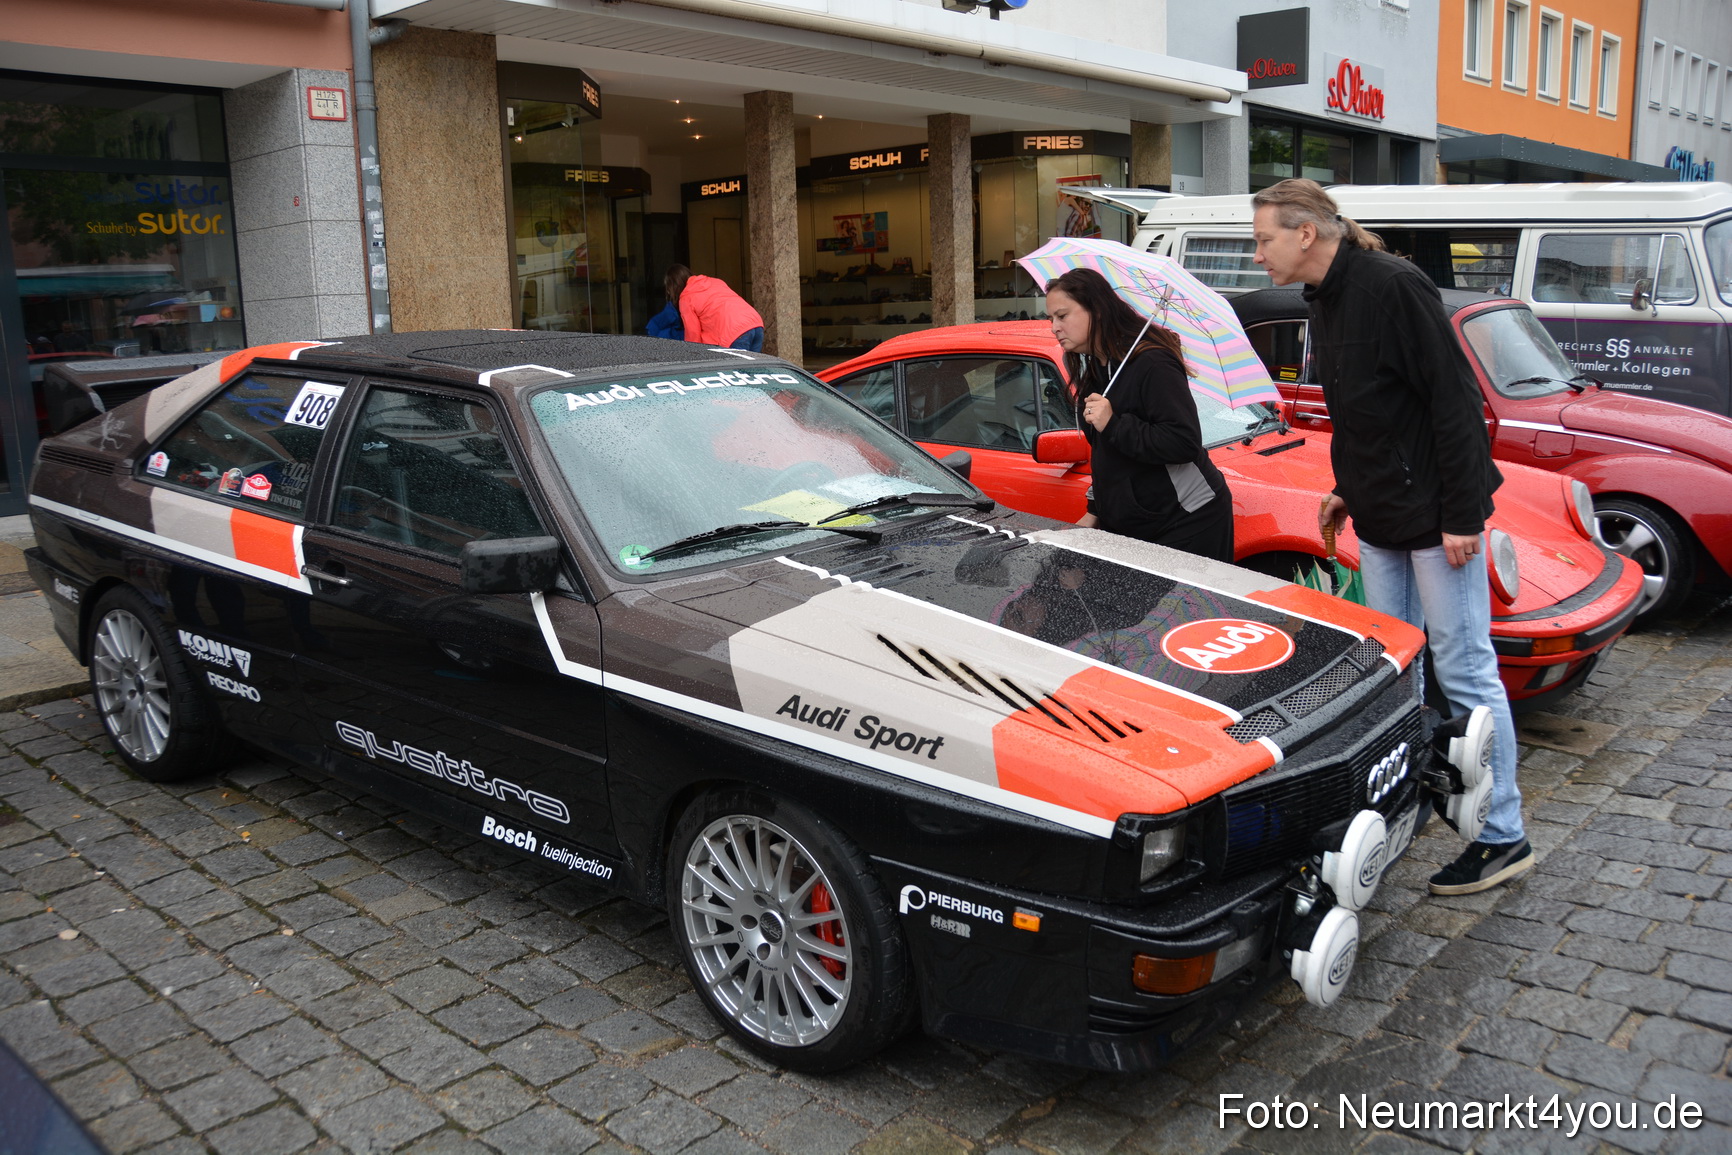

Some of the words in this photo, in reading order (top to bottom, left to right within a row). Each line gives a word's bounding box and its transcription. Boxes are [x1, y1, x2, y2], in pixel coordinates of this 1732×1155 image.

[582, 80, 599, 108] FRIES
[1327, 58, 1385, 119] s.Oliver
[1023, 135, 1084, 150] FRIES
[850, 151, 902, 170] SCHUH
[565, 170, 610, 183] FRIES
[701, 180, 741, 196] SCHUH
[86, 222, 123, 234] Schuhe
[124, 222, 137, 236] by
[1557, 342, 1602, 352] RECHTS
[1633, 343, 1694, 356] ANWÄLTE
[1621, 361, 1691, 377] Kollegen
[564, 384, 646, 411] Audi
[647, 371, 800, 395] quattro
[295, 393, 337, 426] 908
[179, 629, 232, 661] KONI
[1177, 623, 1276, 669] Audi
[207, 671, 261, 702] RECARO
[775, 694, 851, 732] Audi
[853, 715, 945, 760] Sport
[336, 720, 570, 824] quattro
[481, 815, 537, 852] Bosch
[541, 842, 613, 879] fuelinjection
[928, 890, 1004, 924] PIERBURG
